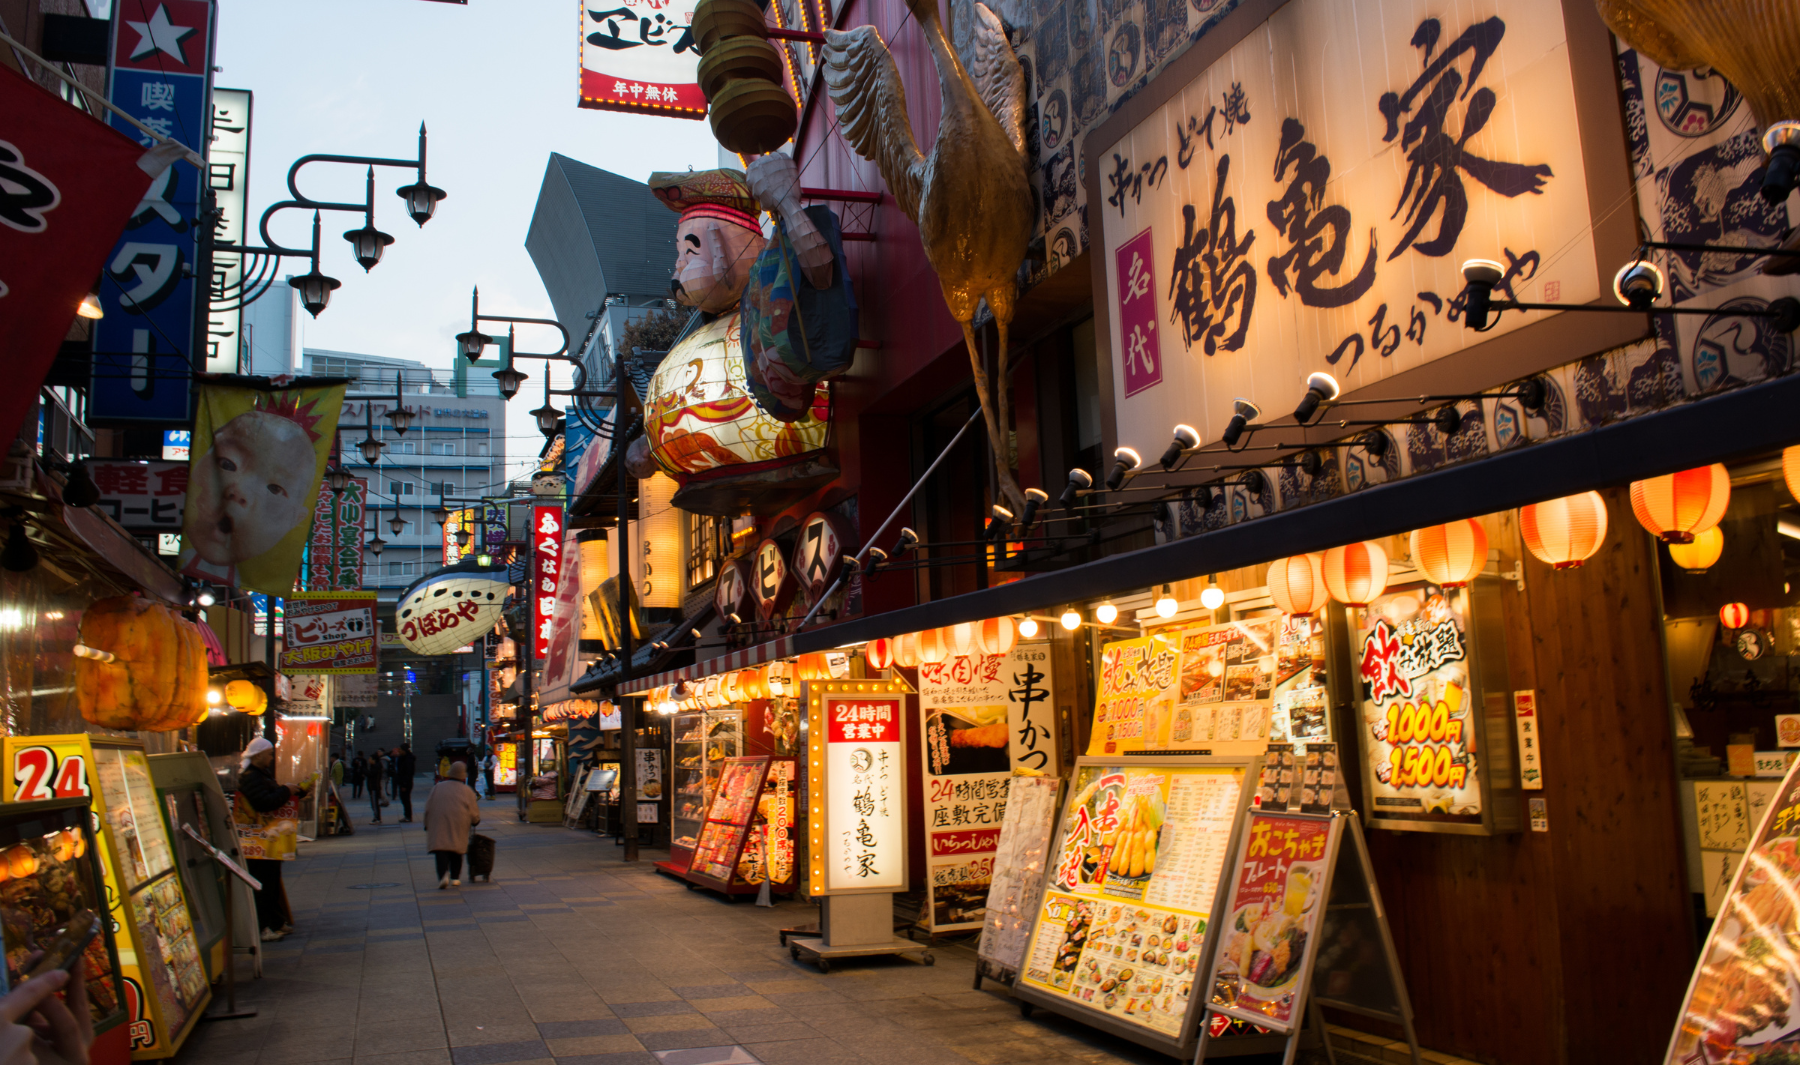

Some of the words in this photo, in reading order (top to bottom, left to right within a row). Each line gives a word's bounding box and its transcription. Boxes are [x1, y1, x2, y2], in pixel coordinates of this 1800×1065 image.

[612, 80, 678, 103] 年中無休
[1107, 153, 1168, 218] 串かつ
[1168, 16, 1556, 358] 鶴亀家
[1122, 251, 1157, 377] 名代
[341, 402, 431, 420] スパワルド
[94, 463, 188, 497] 軽食
[92, 499, 184, 523] コーヒ
[294, 617, 347, 643] ビリーズ
[402, 600, 479, 642] づぼらや
[284, 638, 373, 665] 大阪みやげ
[1361, 619, 1464, 706] 飲み放題
[835, 704, 893, 723] 24時間
[1008, 662, 1051, 770] 串かつ
[841, 722, 886, 740] 営業中
[14, 747, 91, 800] 24
[643, 750, 656, 779] 串かつ
[853, 785, 881, 878] 鶴亀家
[1248, 821, 1326, 859] おこちゃま
[1243, 858, 1287, 885] プレート
